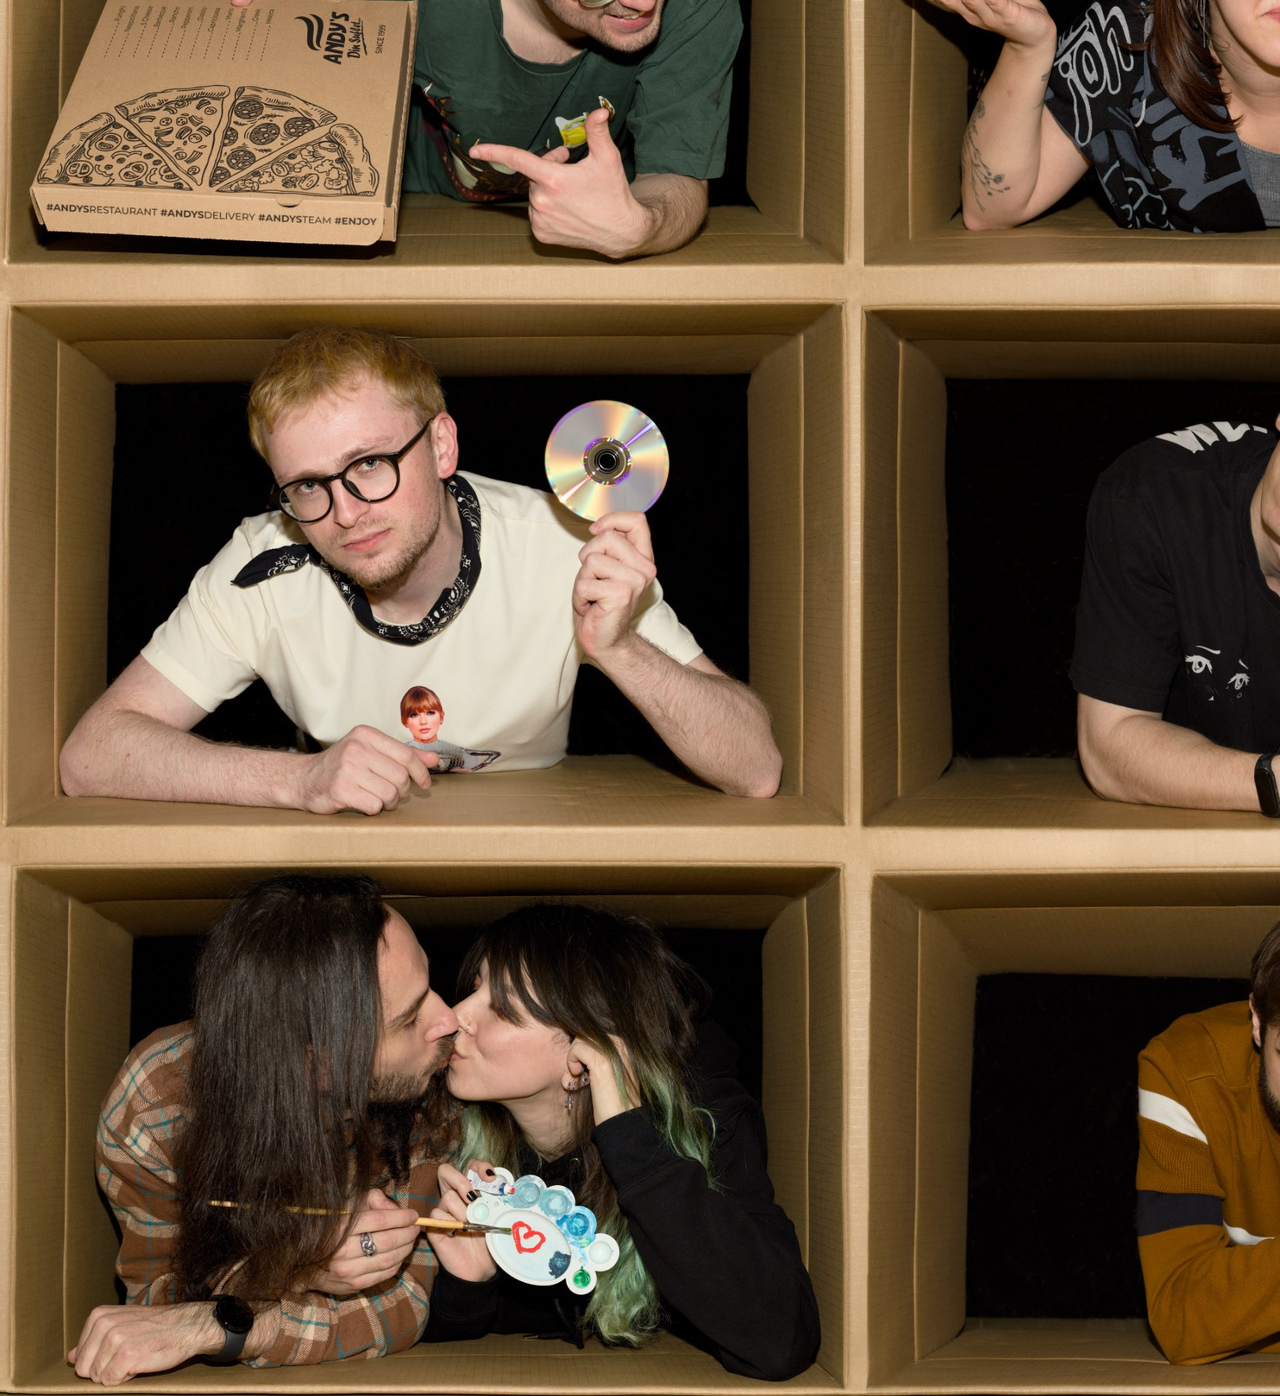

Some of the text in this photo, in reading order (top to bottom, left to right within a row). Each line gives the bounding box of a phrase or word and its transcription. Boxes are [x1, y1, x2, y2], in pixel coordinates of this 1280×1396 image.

[323, 12, 349, 65] ANDY'S
[375, 25, 386, 54] SINCE 1999
[347, 45, 360, 58] Din
[46, 204, 377, 225] #ANDYSRESTAURANT #ANDYSDELIVERY #ANDYSTEAM #ENJOY
